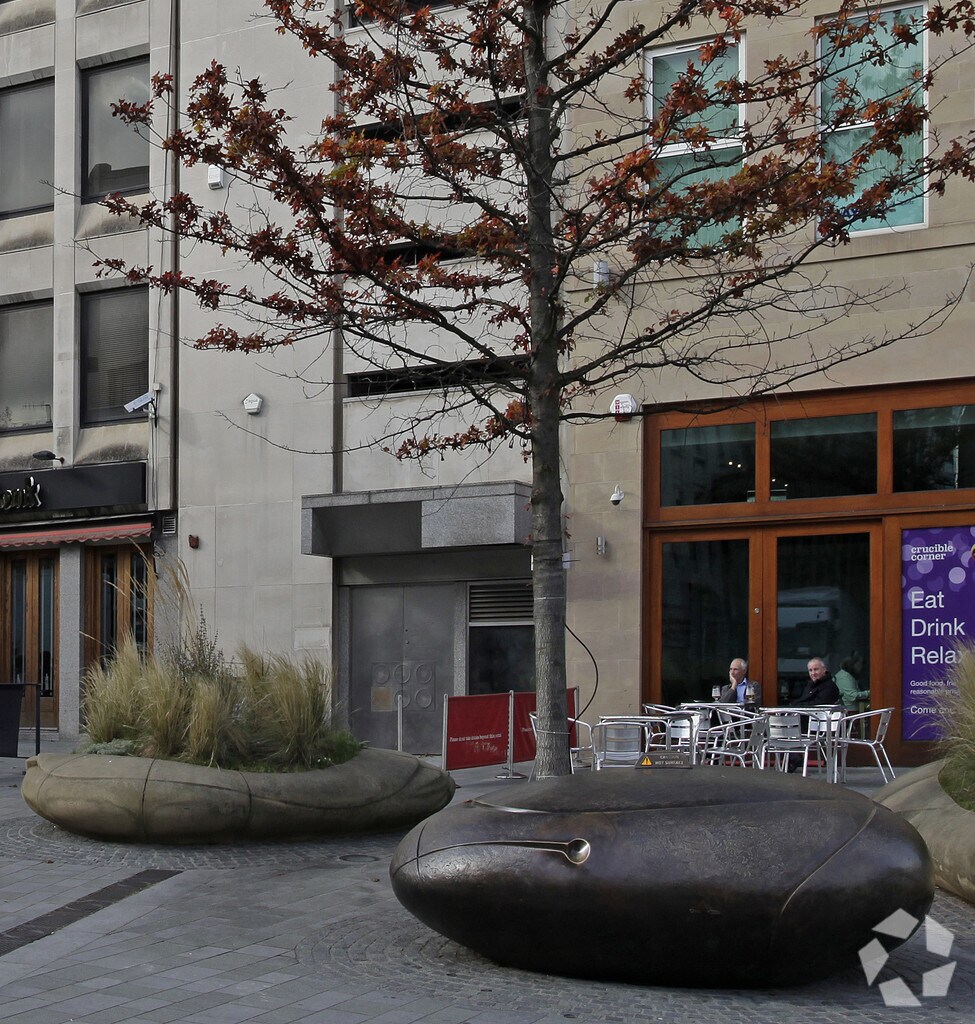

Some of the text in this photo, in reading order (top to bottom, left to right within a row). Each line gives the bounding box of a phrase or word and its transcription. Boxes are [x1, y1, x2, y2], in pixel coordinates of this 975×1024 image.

[911, 543, 954, 554] crucible
[911, 553, 946, 561] corner
[911, 591, 945, 609] Eat
[911, 617, 965, 636] Drink
[910, 705, 936, 714] Come
